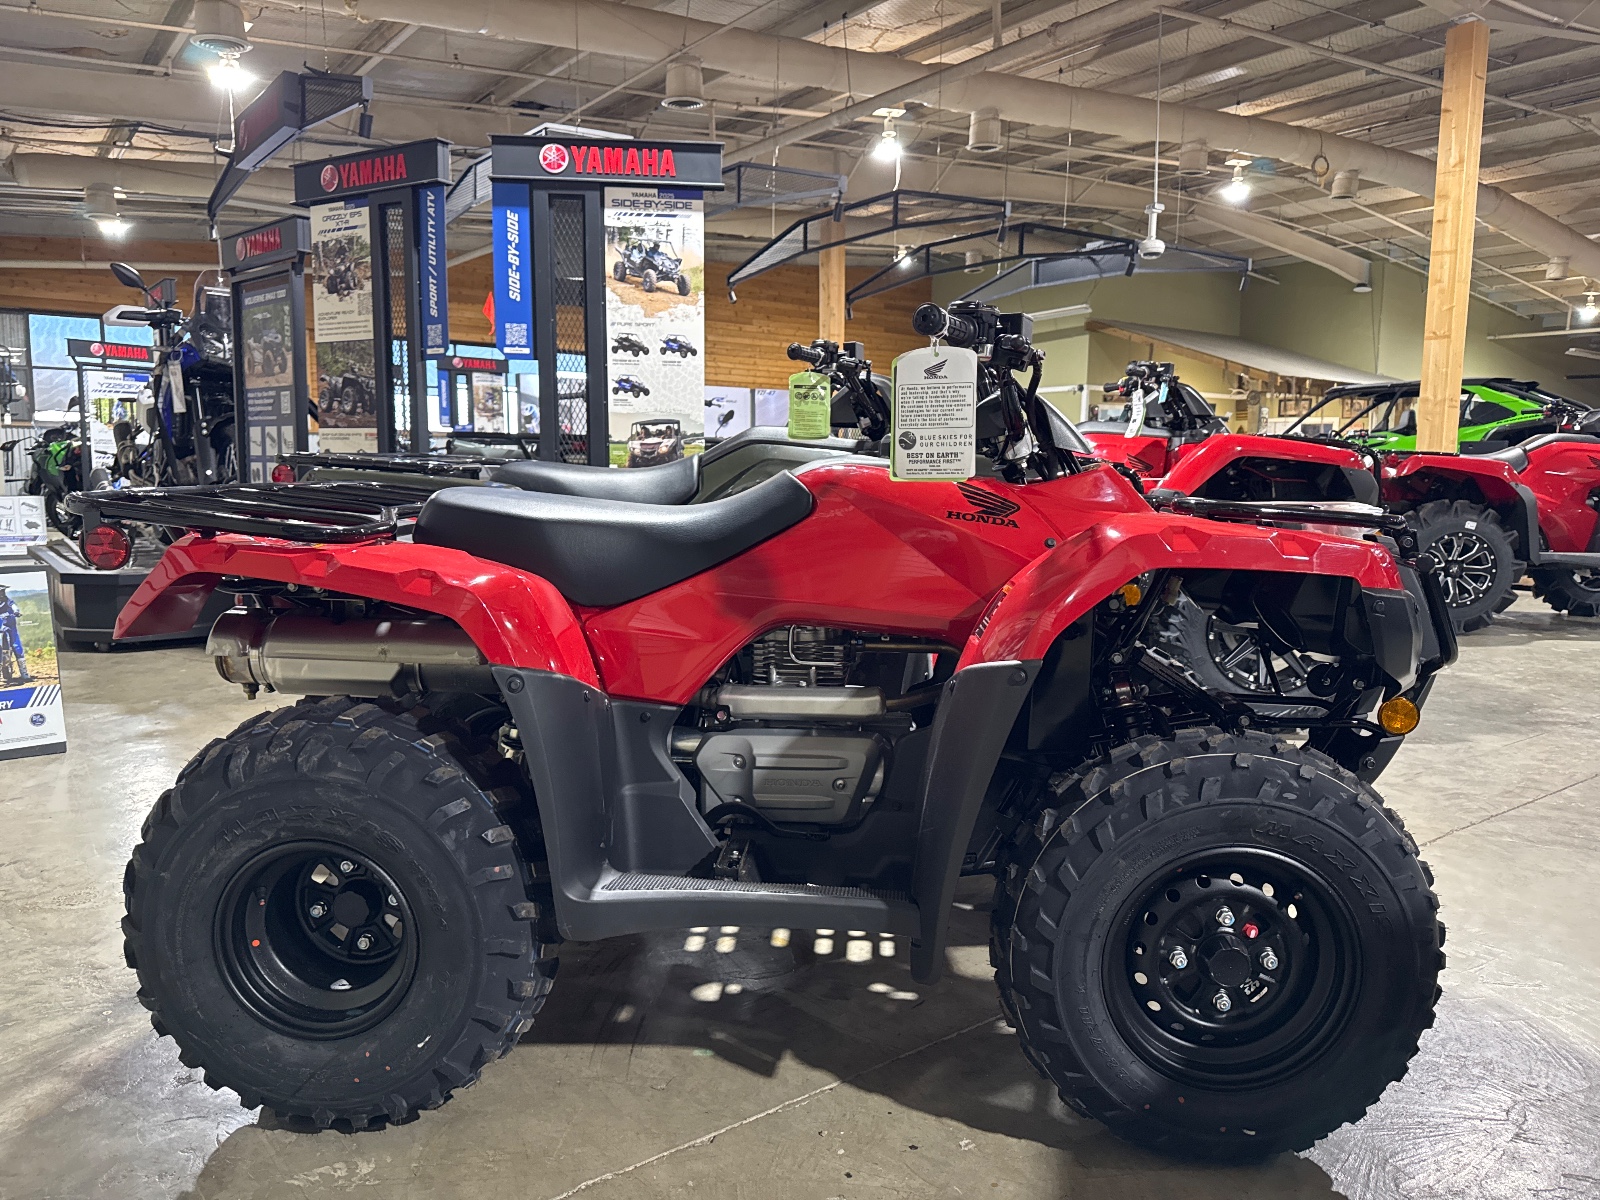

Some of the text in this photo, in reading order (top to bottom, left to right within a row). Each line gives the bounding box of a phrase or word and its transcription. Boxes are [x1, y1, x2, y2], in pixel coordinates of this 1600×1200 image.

[340, 154, 407, 188] YAMAHA
[571, 146, 676, 176] YAMAHA
[322, 212, 348, 222] GRIZZLY
[611, 199, 692, 209] SIDE-BY-SIDE
[245, 227, 282, 257] YAMAHA
[427, 191, 438, 317] SPORT / UTILITY ATV
[507, 210, 521, 302] SIDE-BY-SIDE
[104, 345, 149, 359] YAMAHA
[463, 359, 496, 370] YAMAHA
[946, 510, 1020, 529] HONDA
[215, 805, 405, 852] MAXXIS
[1256, 821, 1394, 933] MAXXIS
